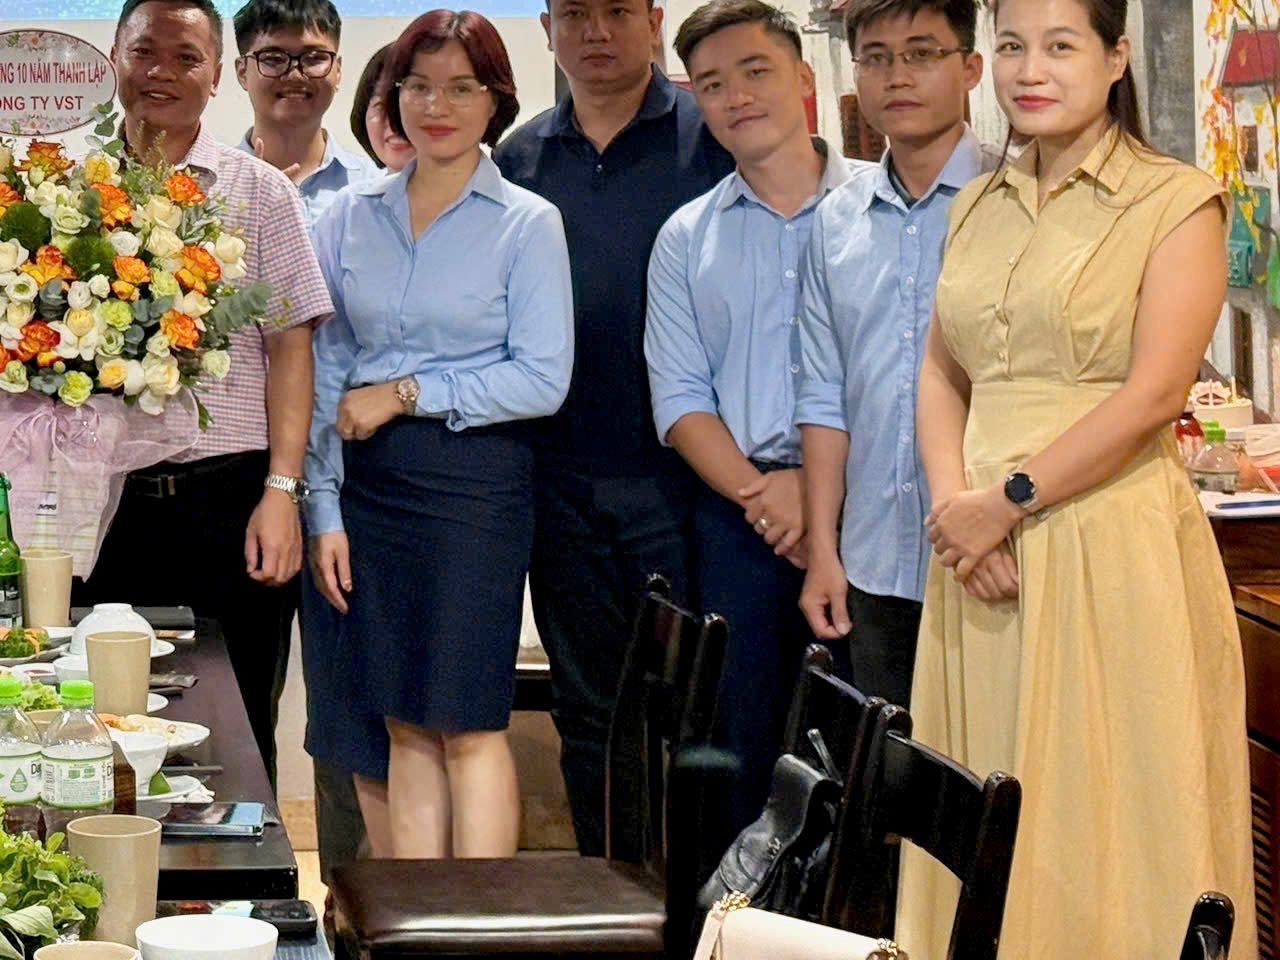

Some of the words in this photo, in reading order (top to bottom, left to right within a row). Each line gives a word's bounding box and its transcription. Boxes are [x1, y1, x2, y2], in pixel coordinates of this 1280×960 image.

[17, 63, 28, 84] 10
[30, 96, 50, 111] TY
[54, 96, 84, 111] VST
